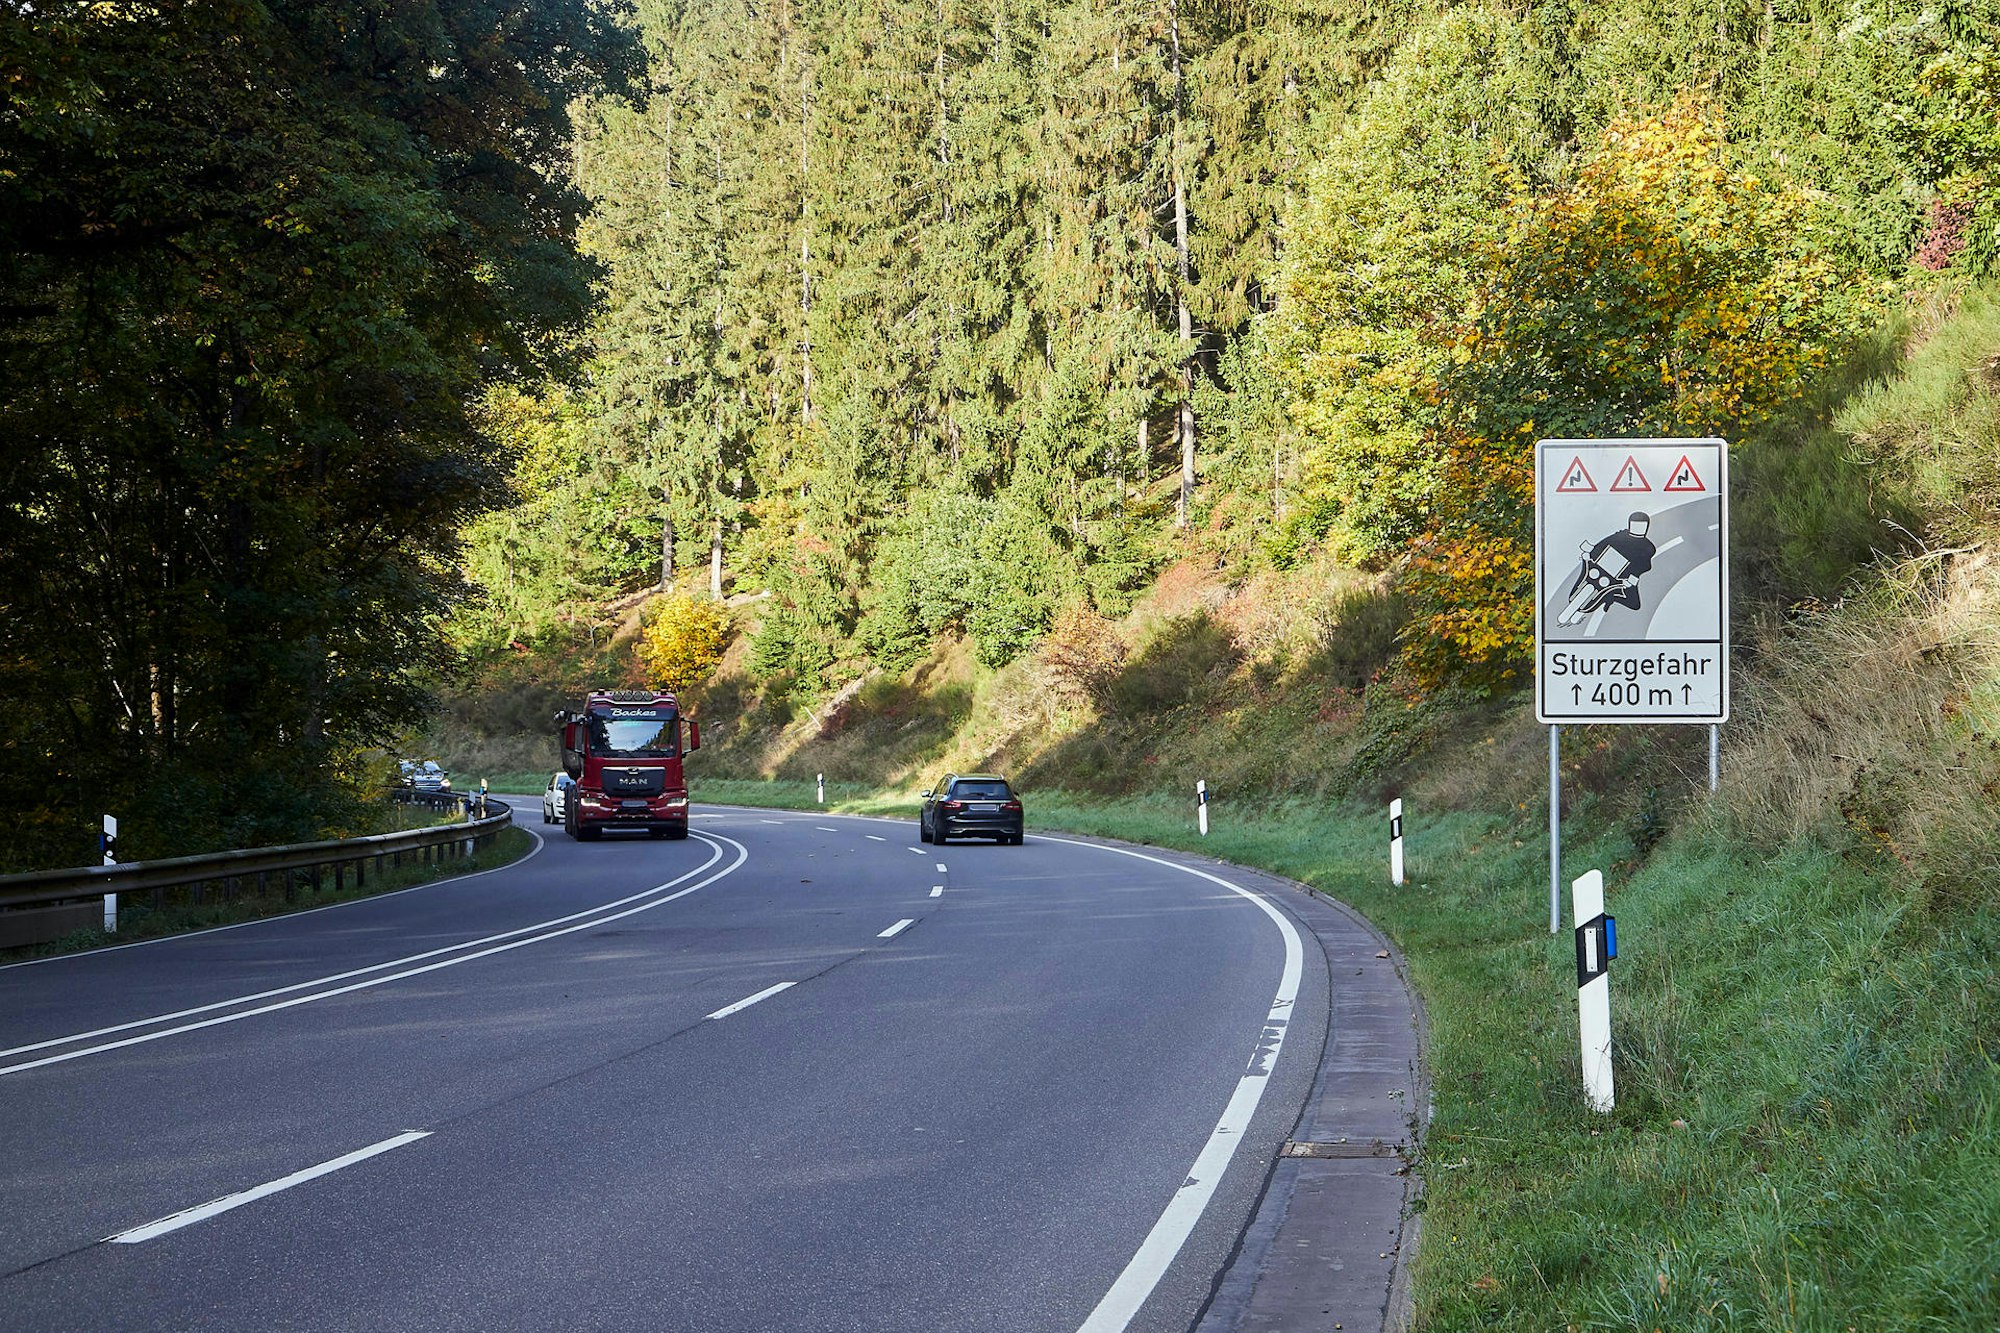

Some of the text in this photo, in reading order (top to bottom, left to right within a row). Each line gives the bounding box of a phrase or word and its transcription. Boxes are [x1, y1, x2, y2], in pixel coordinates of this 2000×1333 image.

[1552, 652, 1712, 681] Sturzgefahr
[1591, 683, 1672, 705] 400 m
[610, 708, 656, 717] Backes
